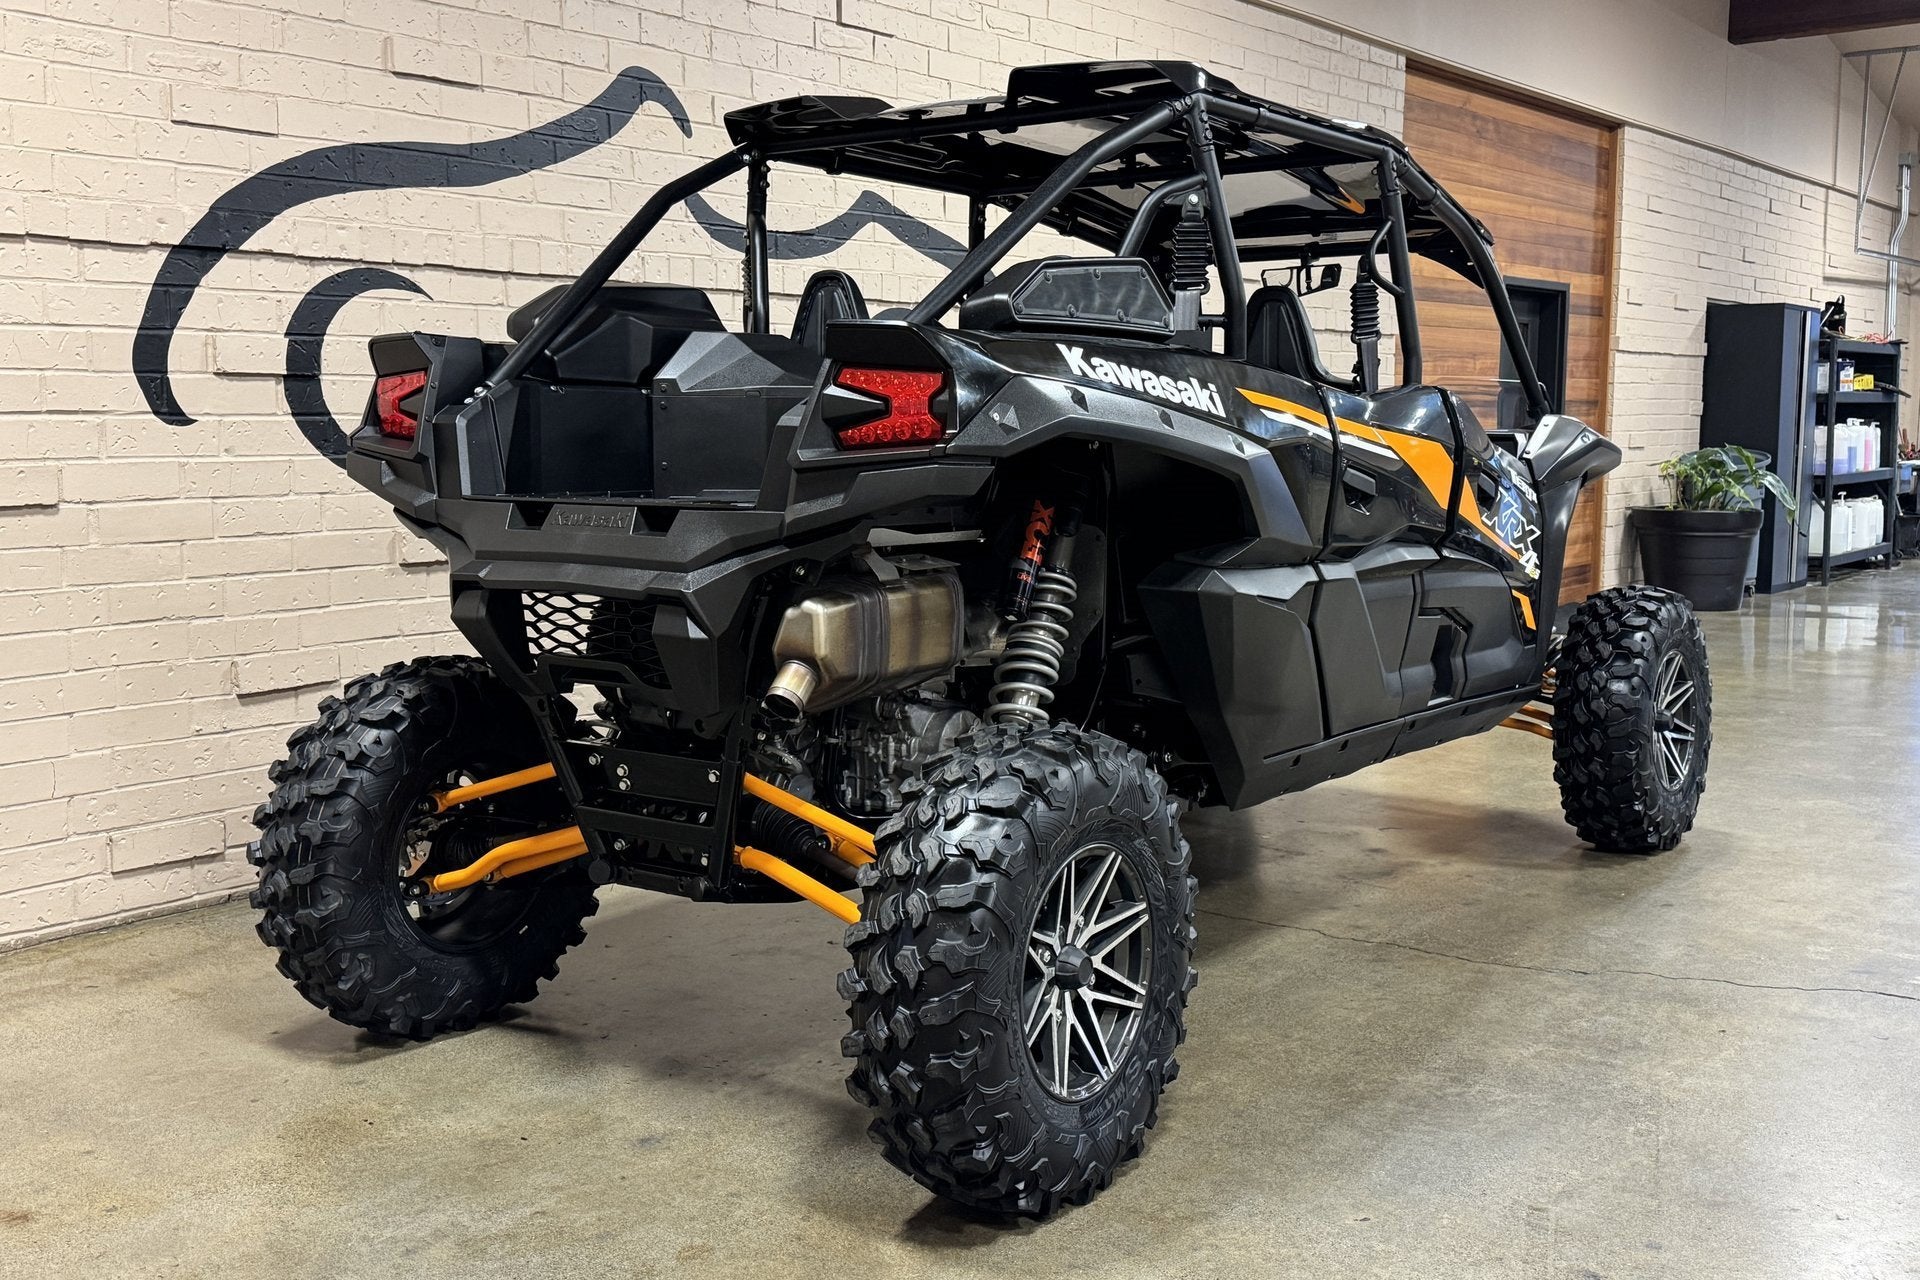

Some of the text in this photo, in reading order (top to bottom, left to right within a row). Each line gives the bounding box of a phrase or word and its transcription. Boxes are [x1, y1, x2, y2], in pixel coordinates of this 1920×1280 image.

[1055, 343, 1226, 418] Kawasaki
[551, 509, 632, 529] Kawasaki
[1020, 500, 1055, 566] FOX
